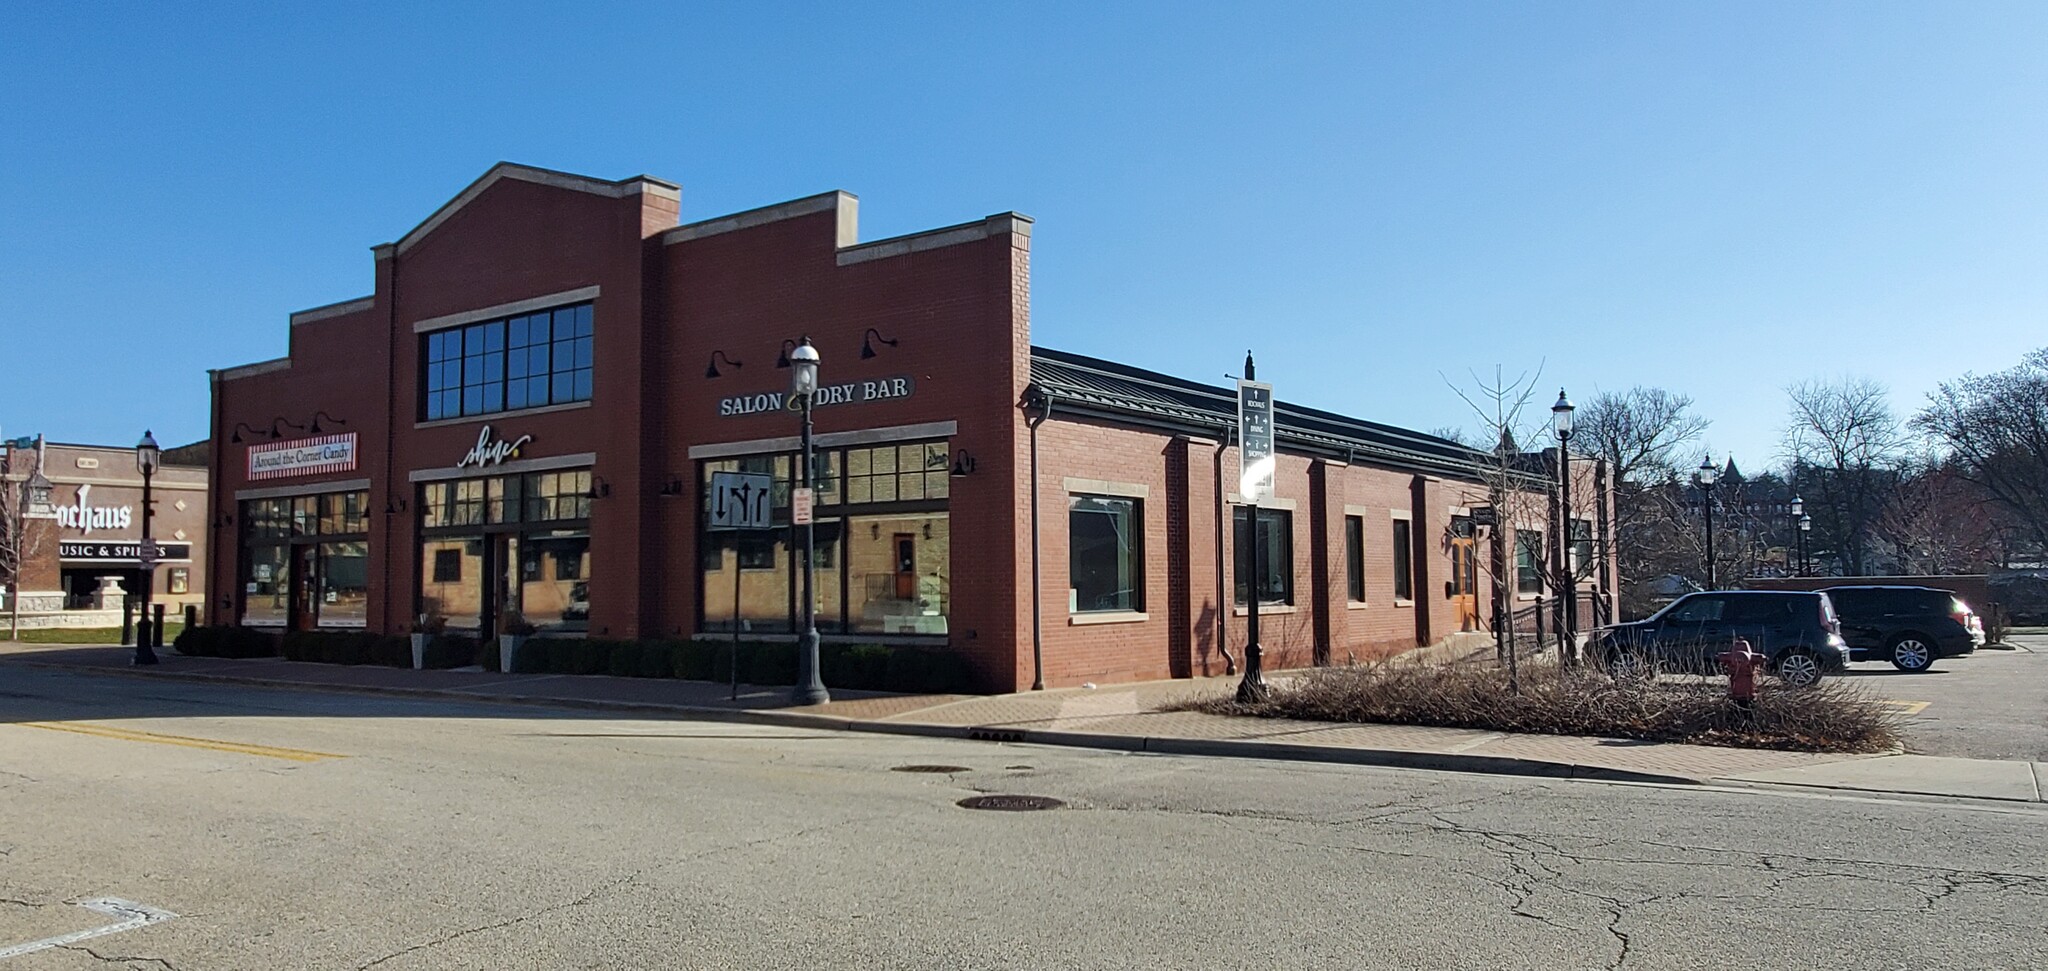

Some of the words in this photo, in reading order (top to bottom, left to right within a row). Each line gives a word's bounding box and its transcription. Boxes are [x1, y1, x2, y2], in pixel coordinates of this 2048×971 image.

[721, 392, 782, 416] SALON
[816, 384, 855, 406] DRY
[864, 378, 908, 400] BAR
[255, 453, 281, 468] Around
[283, 452, 295, 465] the
[296, 449, 322, 463] Corner
[323, 444, 350, 462] Candy
[51, 484, 133, 536] ochaus
[60, 545, 94, 556] USIC
[99, 546, 110, 556] &
[114, 546, 166, 557] SPIS
